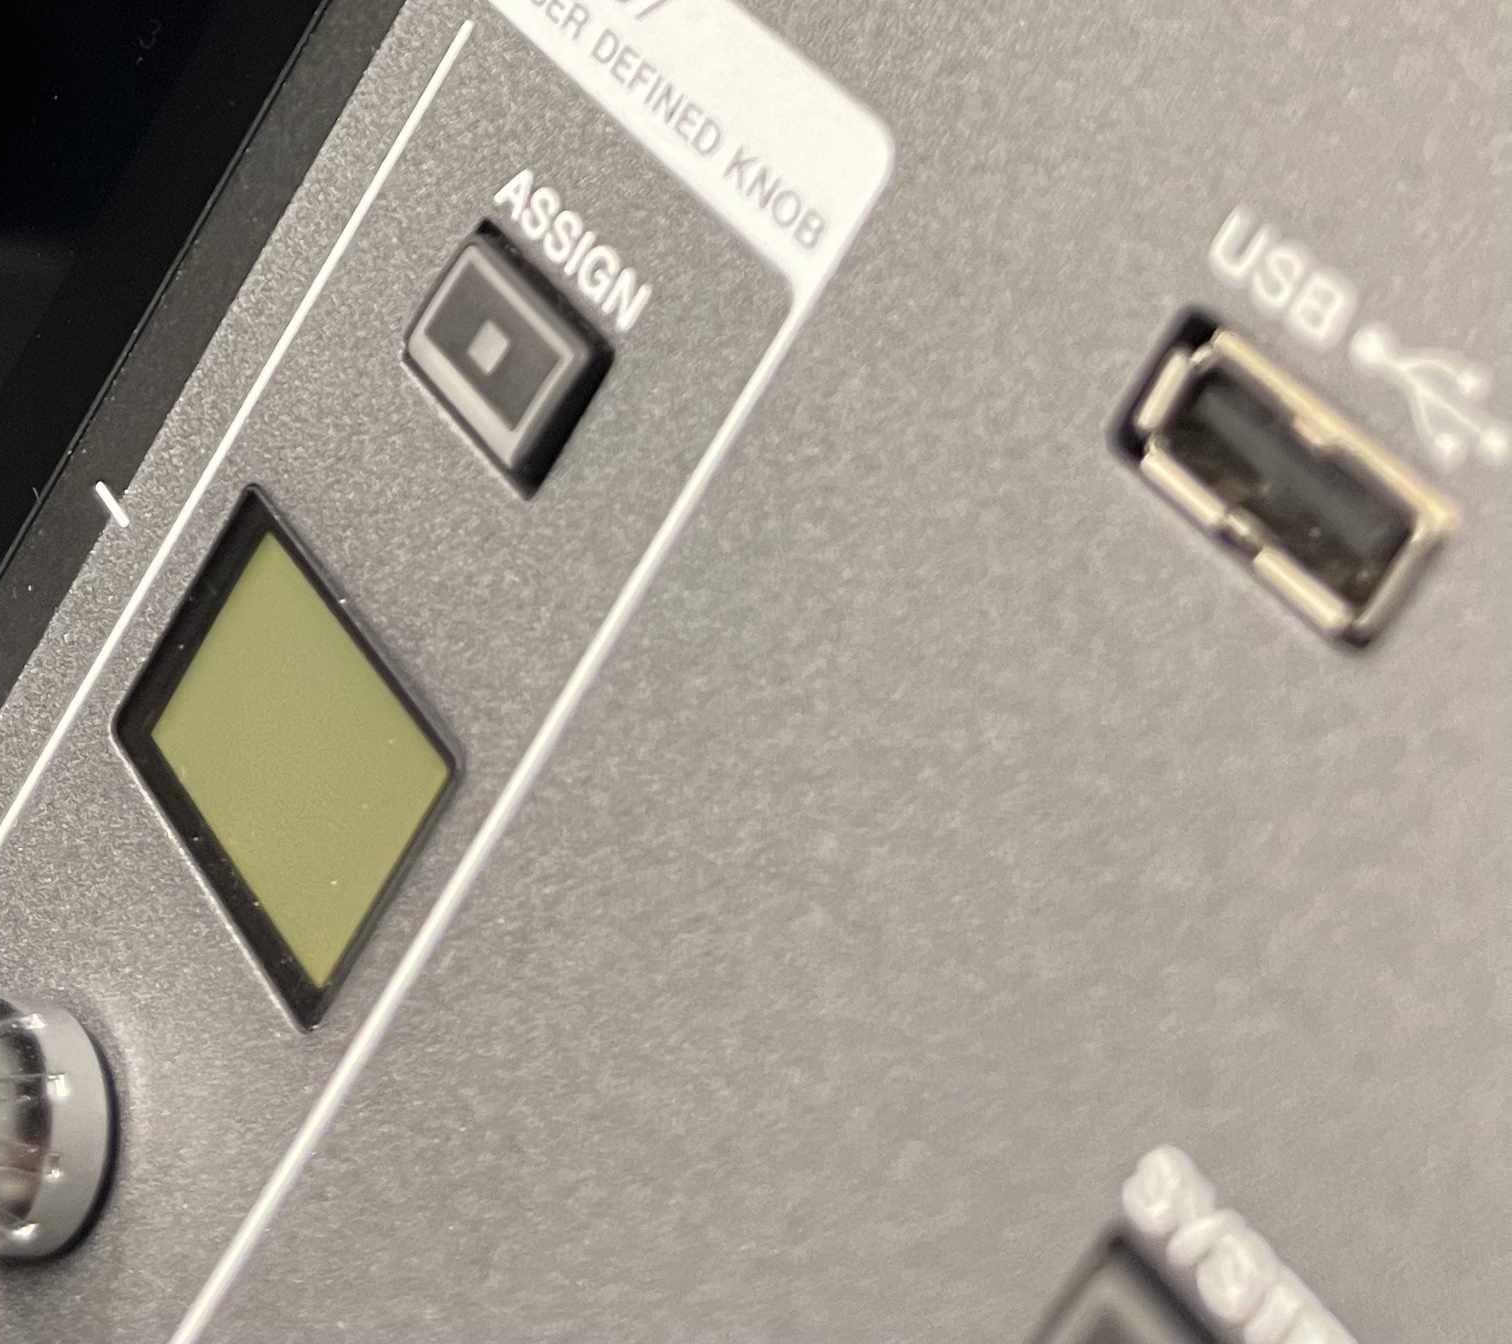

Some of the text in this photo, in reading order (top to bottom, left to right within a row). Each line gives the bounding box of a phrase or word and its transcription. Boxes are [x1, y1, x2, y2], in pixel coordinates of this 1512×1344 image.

[593, 30, 725, 156] DEFINED
[724, 145, 826, 251] KNOB
[493, 169, 652, 333] ASSIGN
[1207, 206, 1357, 349] USB
